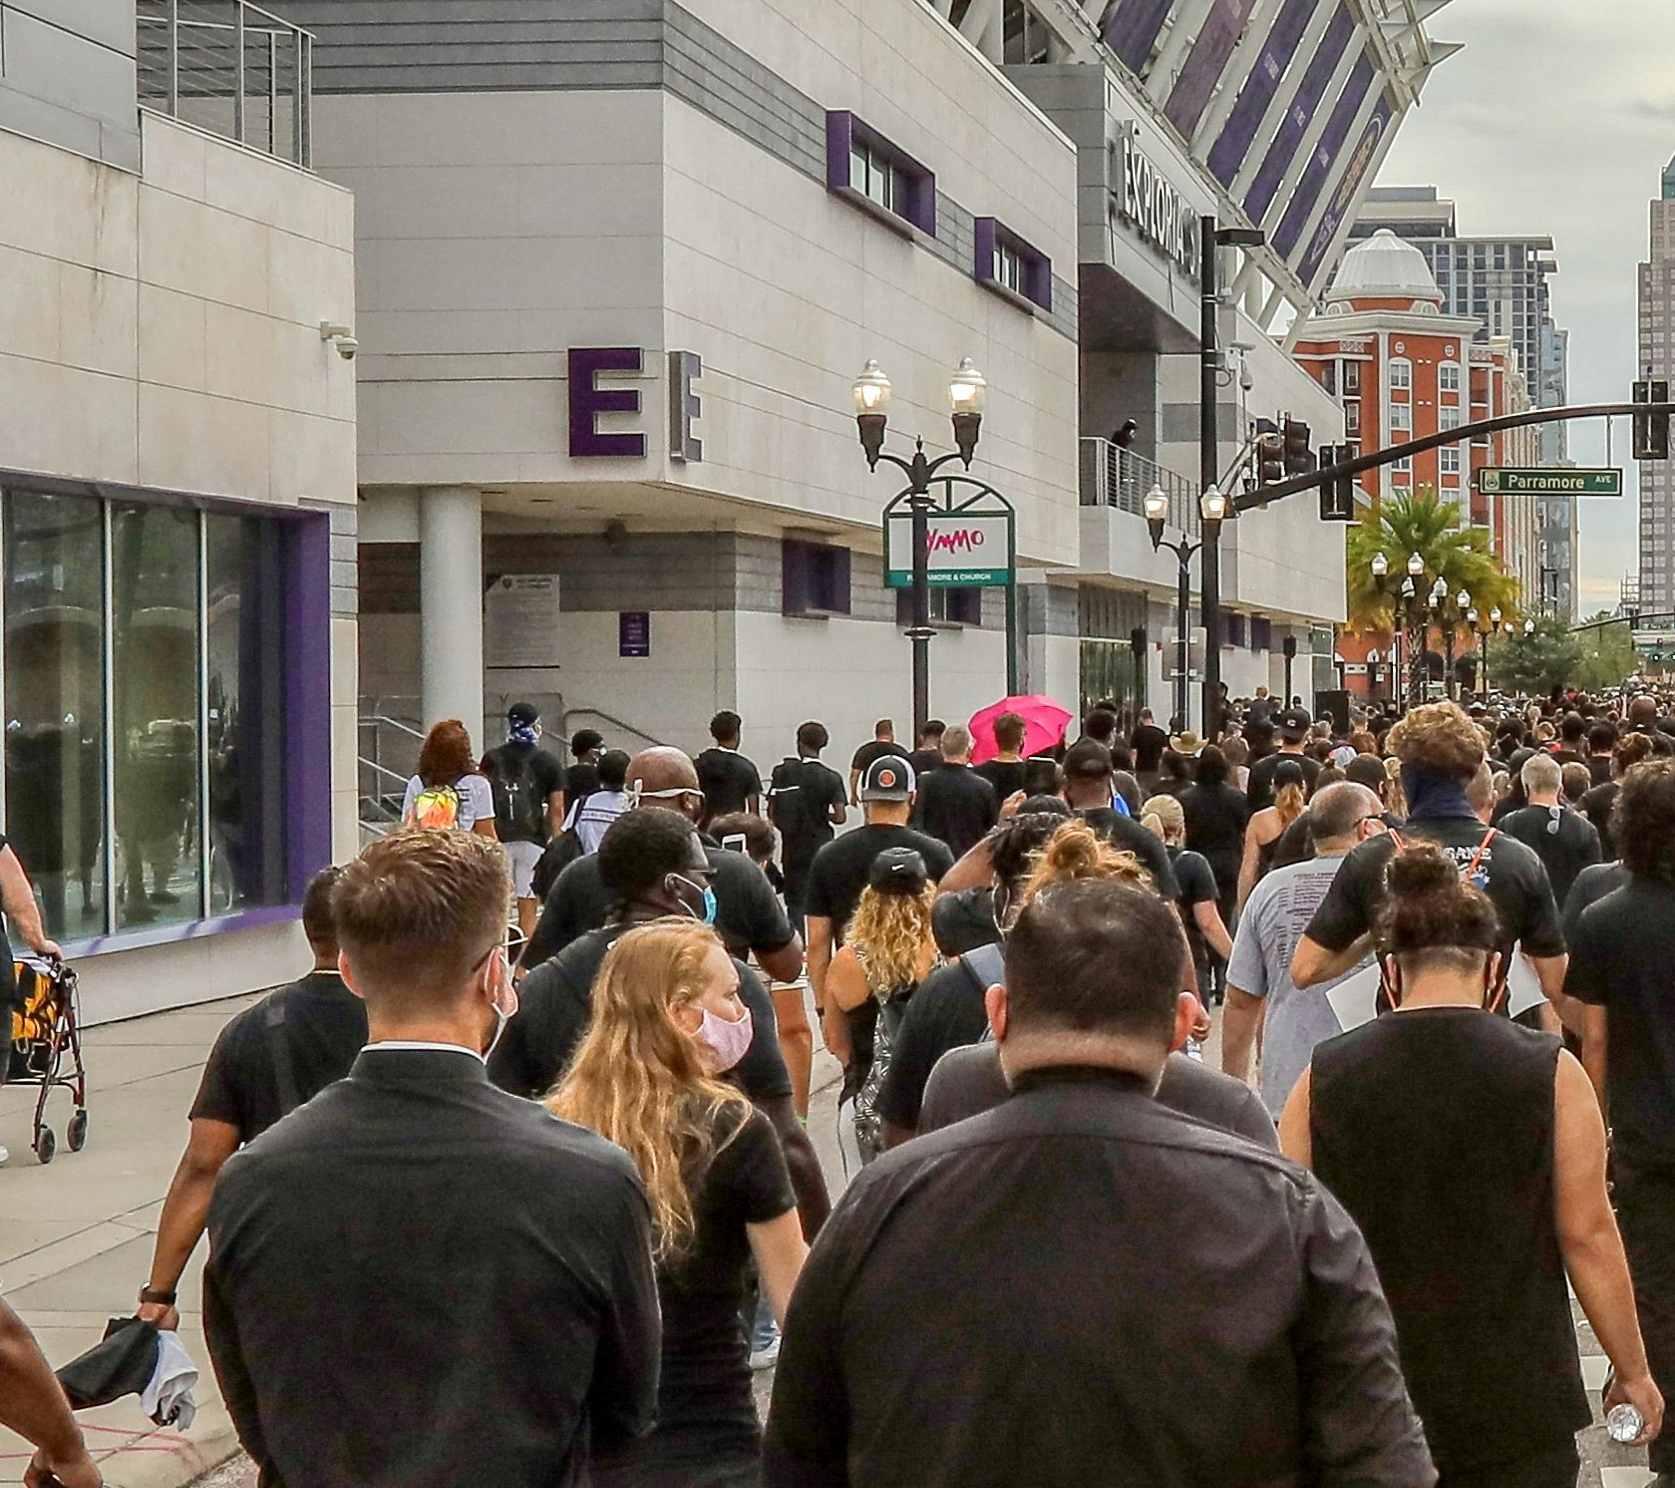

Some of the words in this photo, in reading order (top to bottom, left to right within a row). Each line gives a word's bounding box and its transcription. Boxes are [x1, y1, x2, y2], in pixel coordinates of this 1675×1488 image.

[568, 346, 647, 458] E
[669, 350, 702, 462] E
[1508, 474, 1585, 489] Parramore
[1595, 475, 1612, 483] AVE
